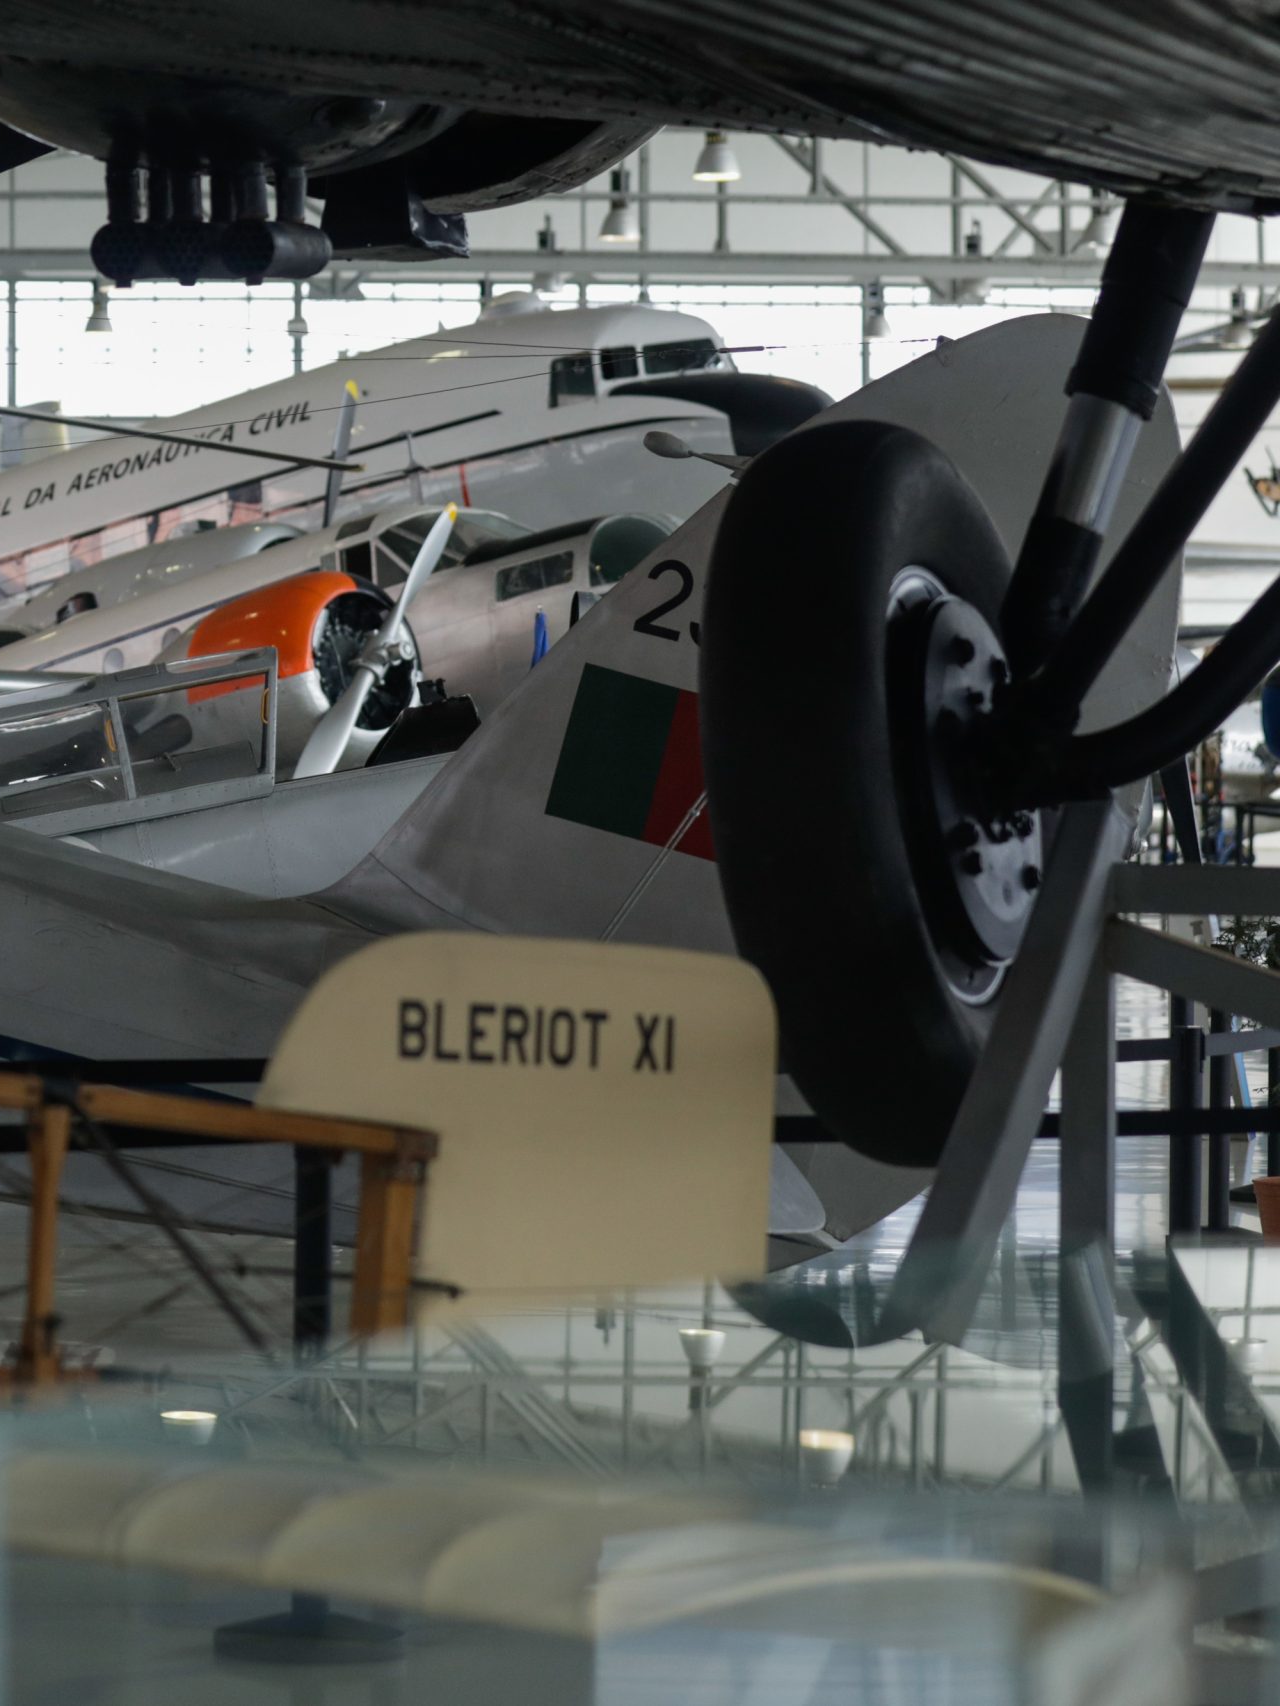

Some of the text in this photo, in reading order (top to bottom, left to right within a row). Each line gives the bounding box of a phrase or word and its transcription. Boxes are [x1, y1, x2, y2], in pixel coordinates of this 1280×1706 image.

[23, 482, 56, 510] DA
[248, 400, 311, 436] CIVIL
[633, 559, 701, 648] 2
[398, 998, 675, 1074] BLERIOT XI
